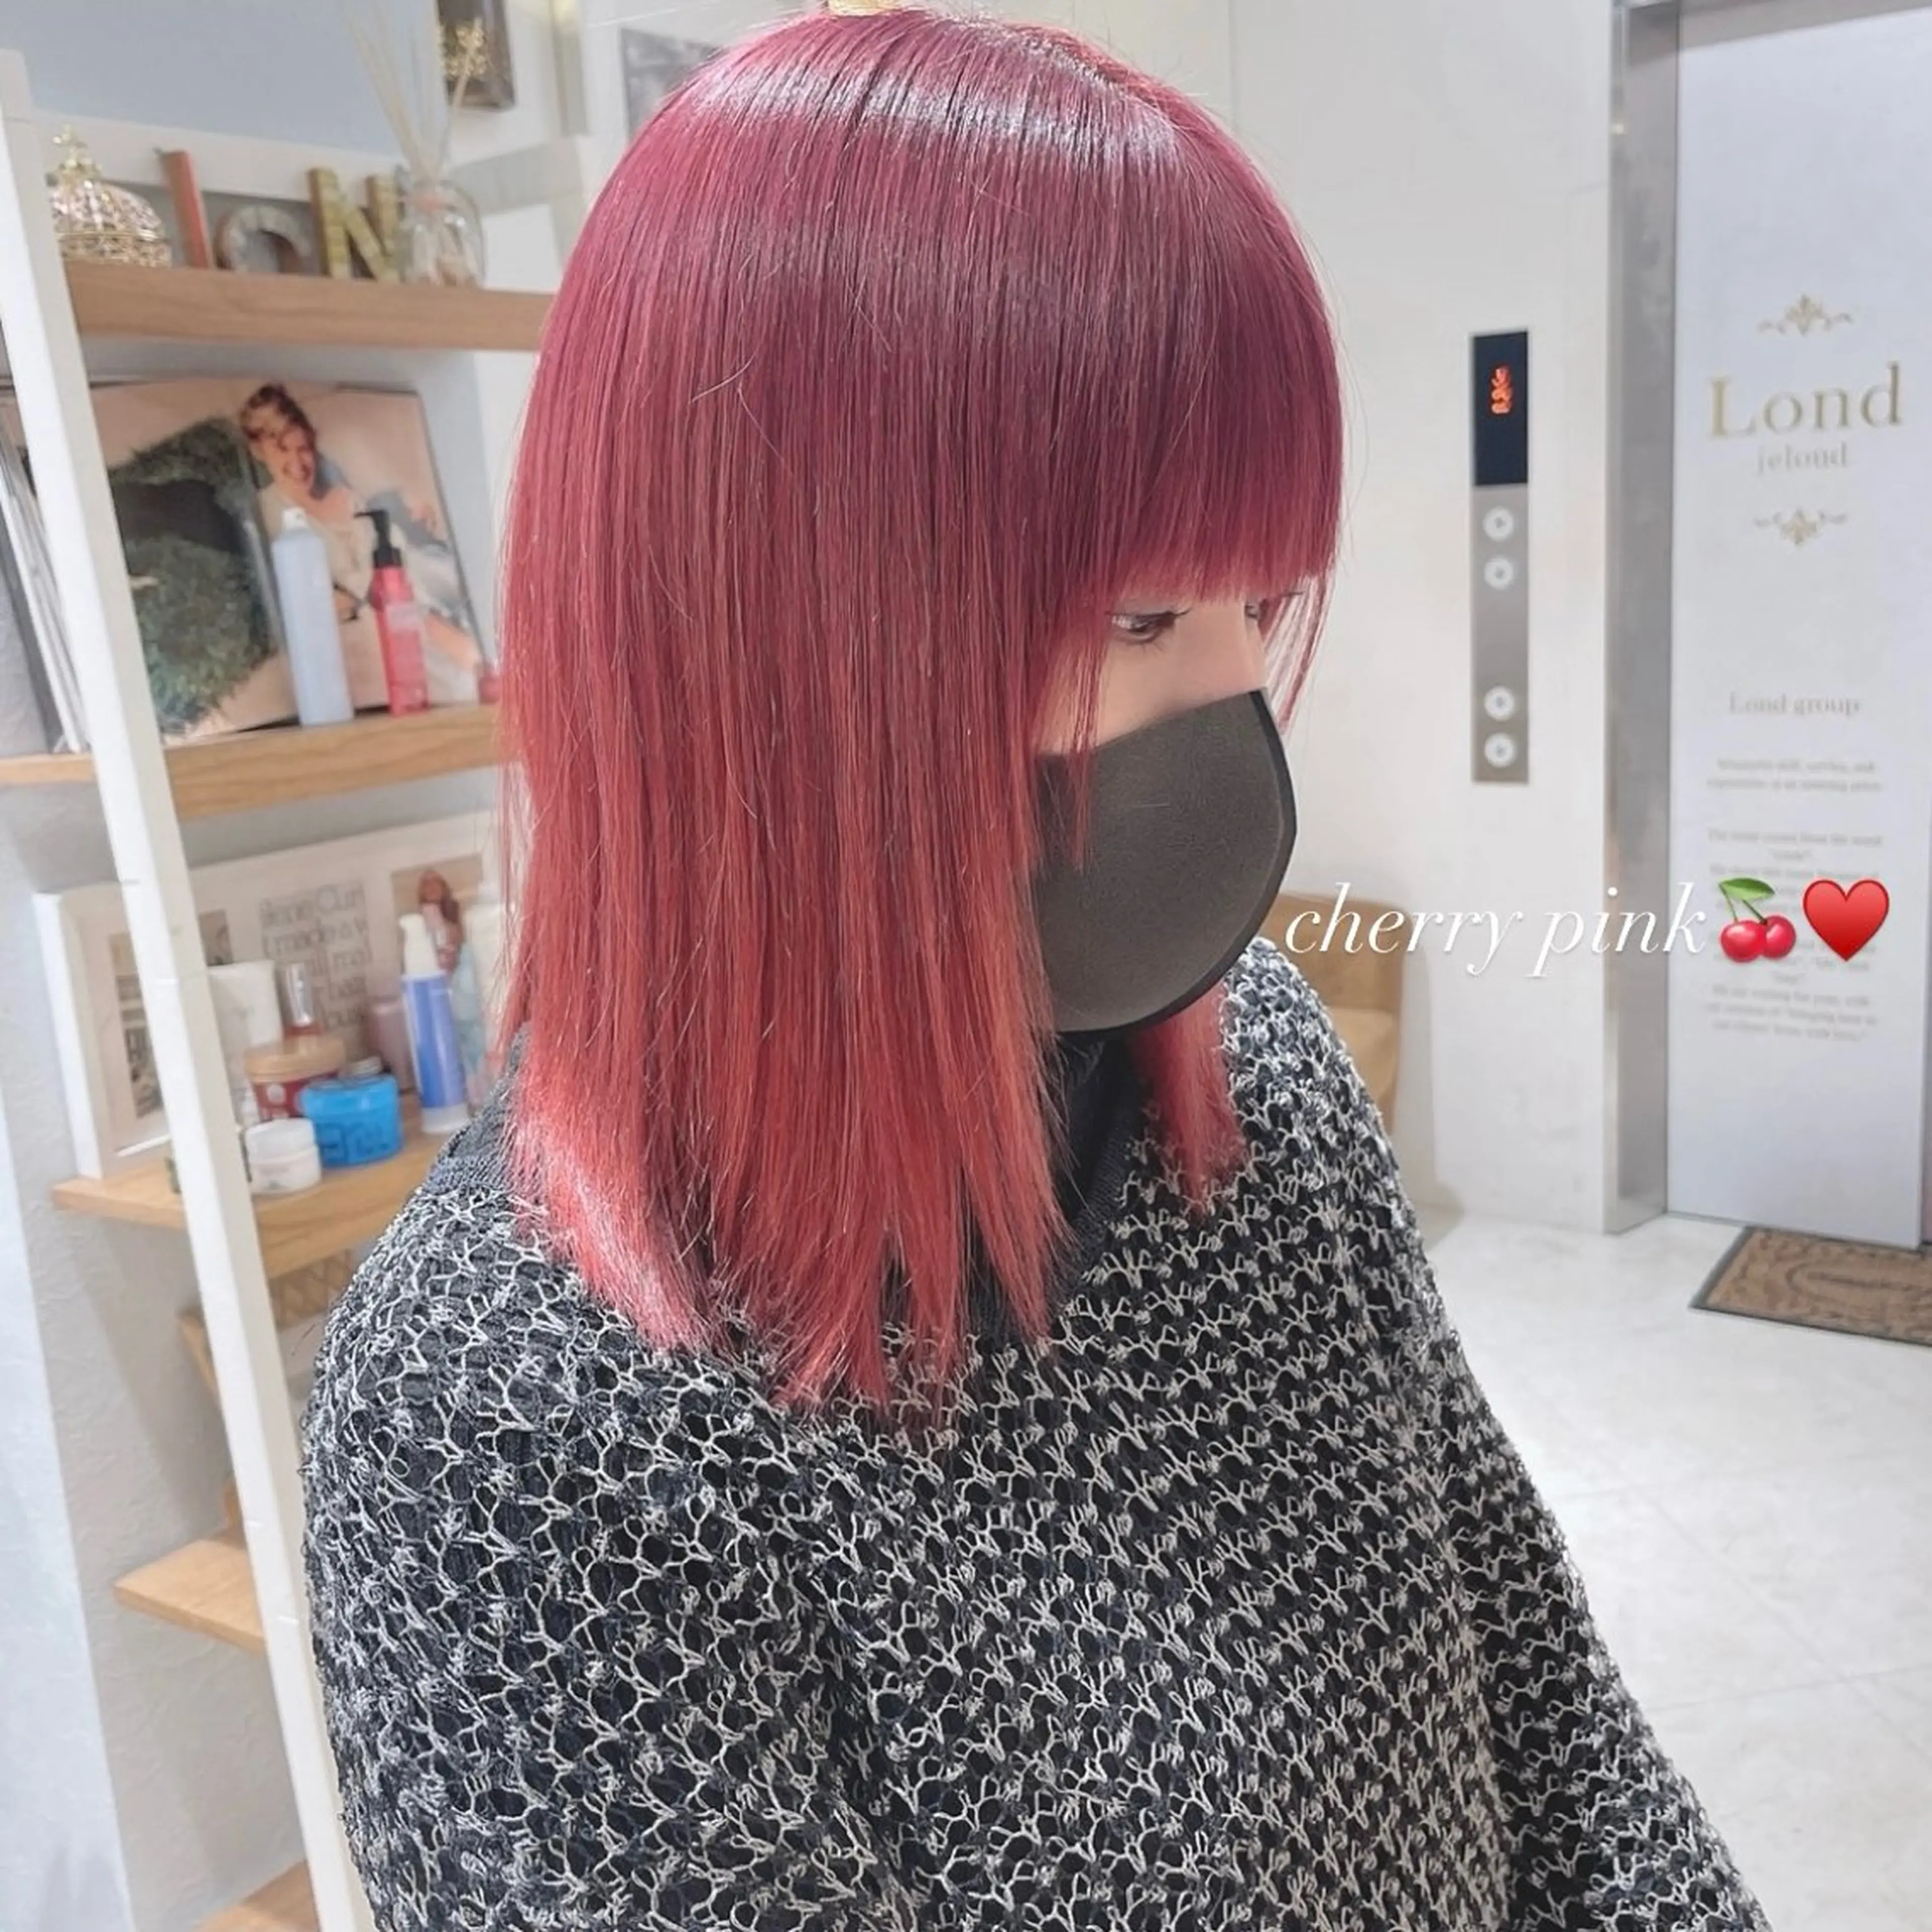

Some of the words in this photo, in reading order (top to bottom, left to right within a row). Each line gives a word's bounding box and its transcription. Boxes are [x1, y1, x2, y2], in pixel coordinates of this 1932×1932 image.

[1708, 360, 1901, 438] Lond
[1729, 690, 1787, 714] Lond
[1793, 696, 1862, 718] group
